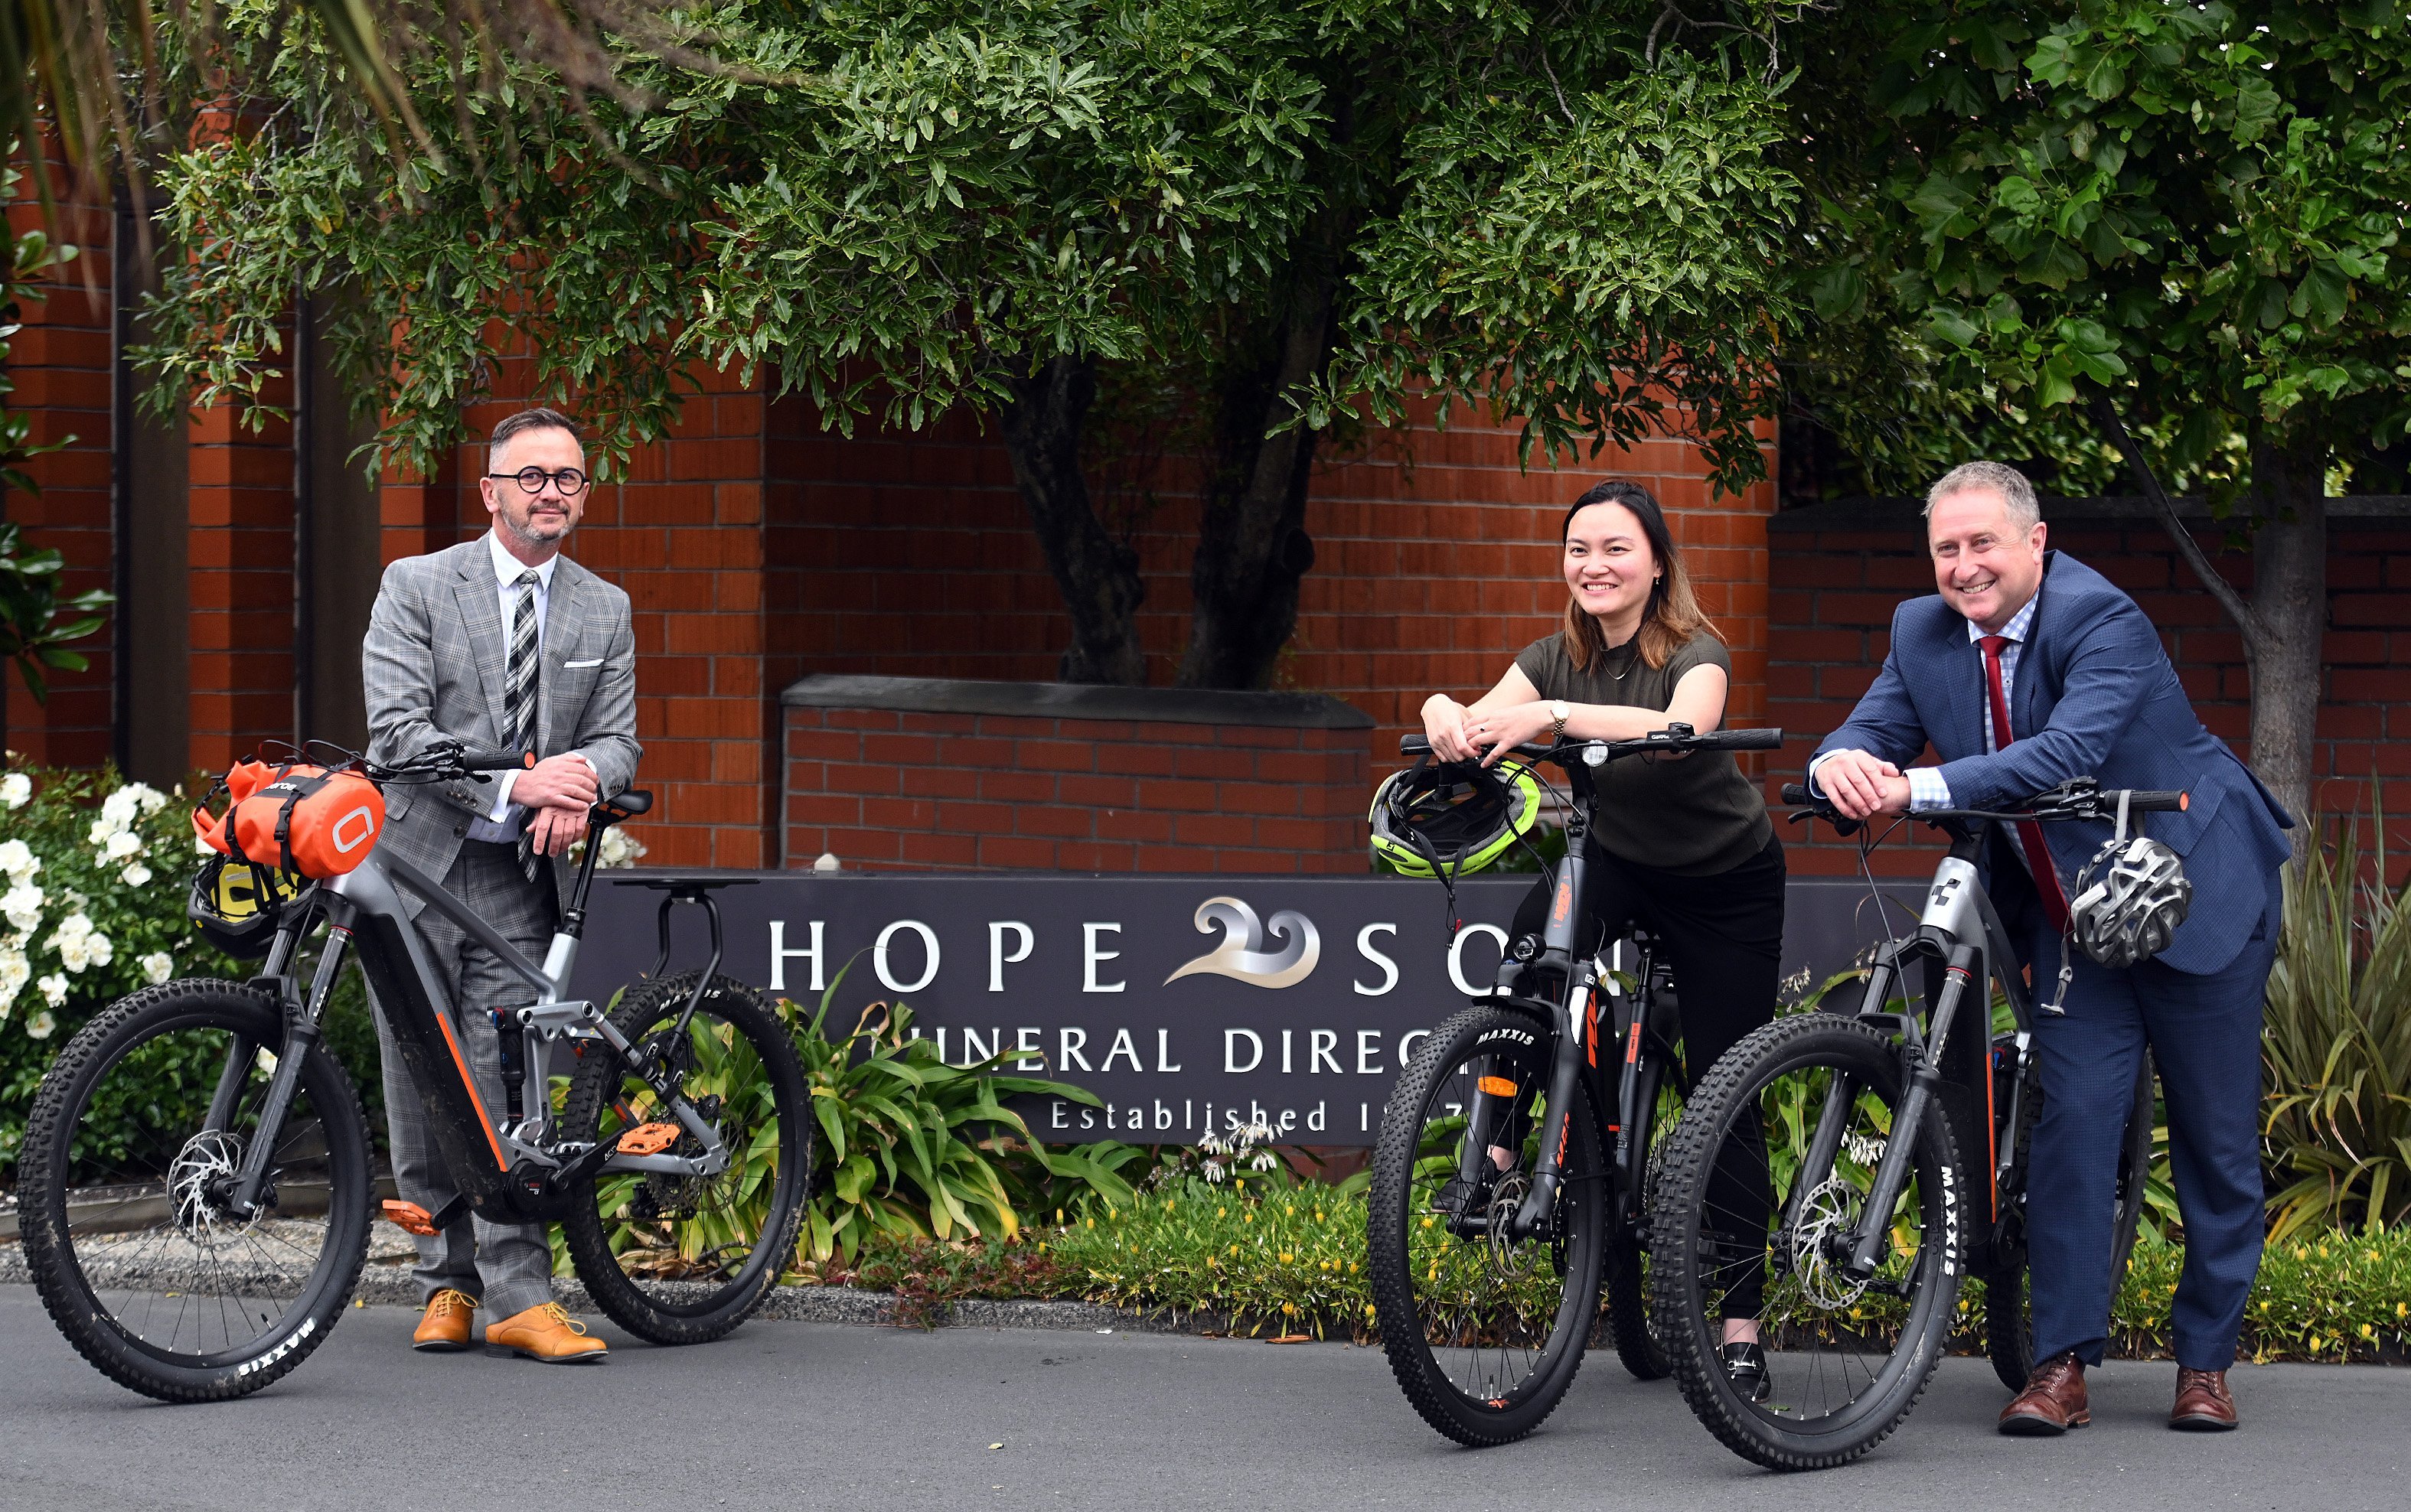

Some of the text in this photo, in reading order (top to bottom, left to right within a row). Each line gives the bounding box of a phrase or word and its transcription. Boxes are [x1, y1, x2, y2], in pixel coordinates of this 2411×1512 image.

[769, 920, 1127, 993] HOPE
[658, 989, 721, 1013] MAXIS
[871, 1027, 1470, 1074] UNERAL DIREC
[1476, 1028, 1535, 1046] MAXXIS
[1052, 1098, 1326, 1131] Established
[1941, 1165, 1956, 1277] MAXXIS
[237, 1316, 316, 1376] MAXXIS
